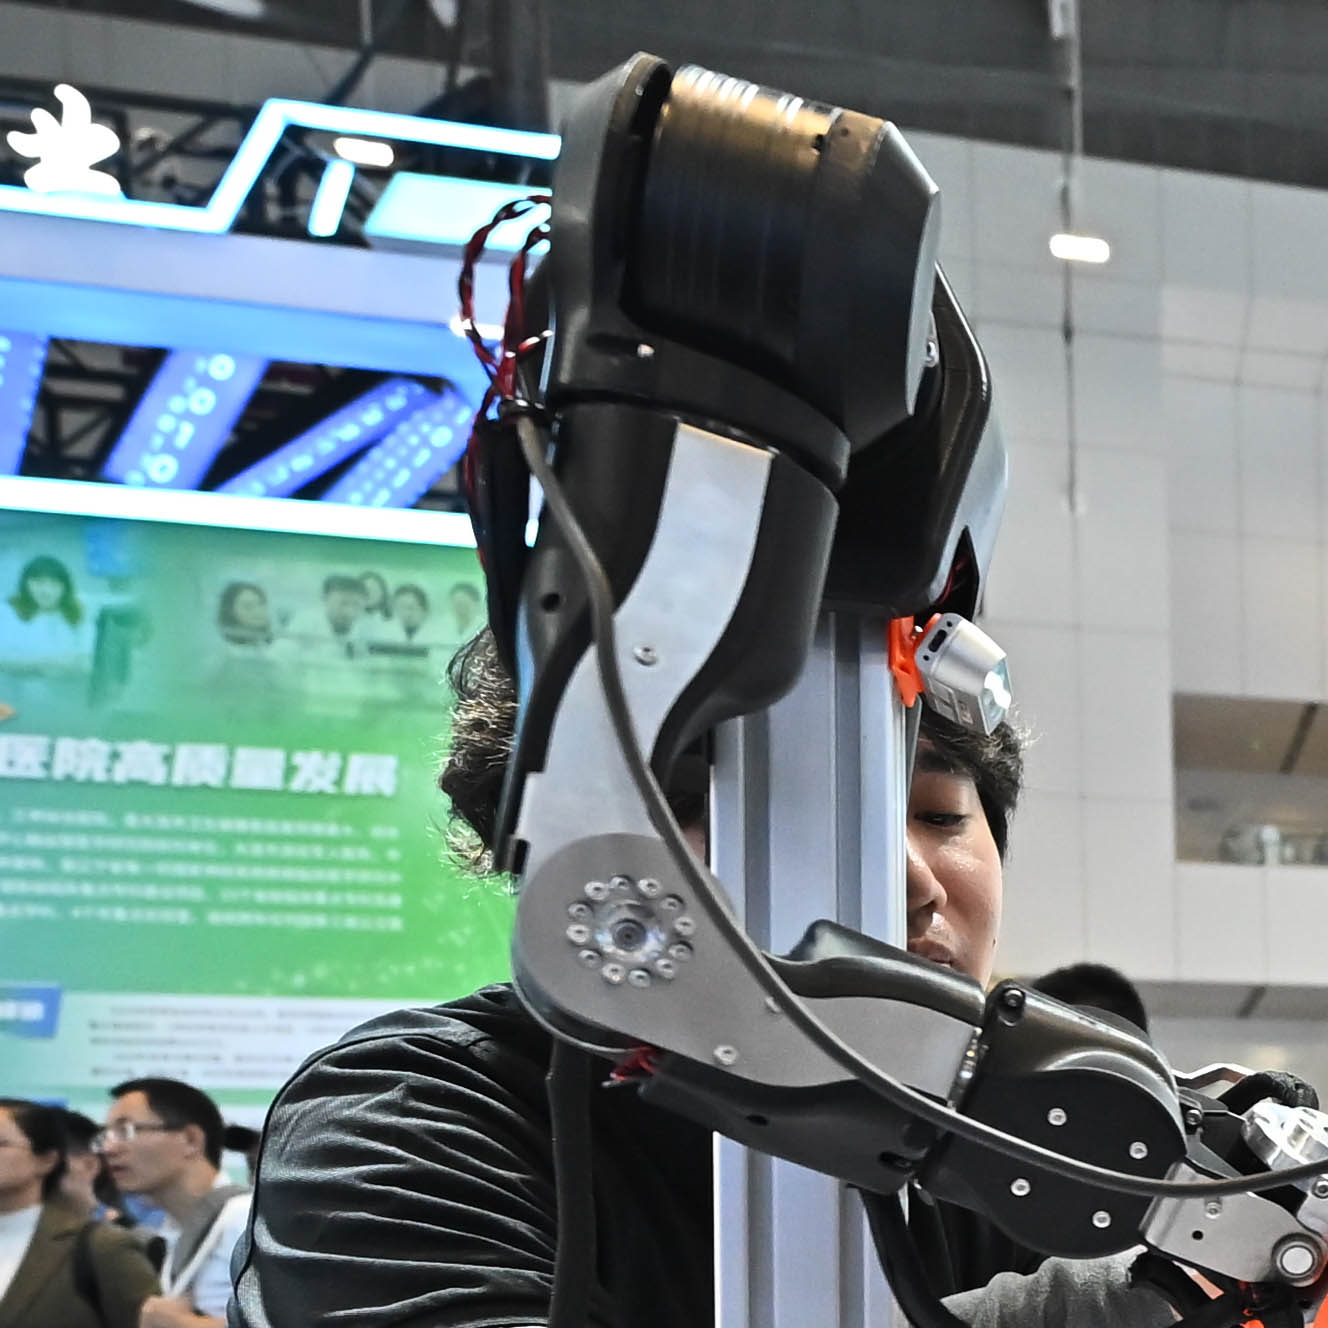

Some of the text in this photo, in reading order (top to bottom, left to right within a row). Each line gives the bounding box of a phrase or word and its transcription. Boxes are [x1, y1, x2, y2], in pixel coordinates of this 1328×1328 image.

[0, 734, 398, 797] 医院高质量发展
